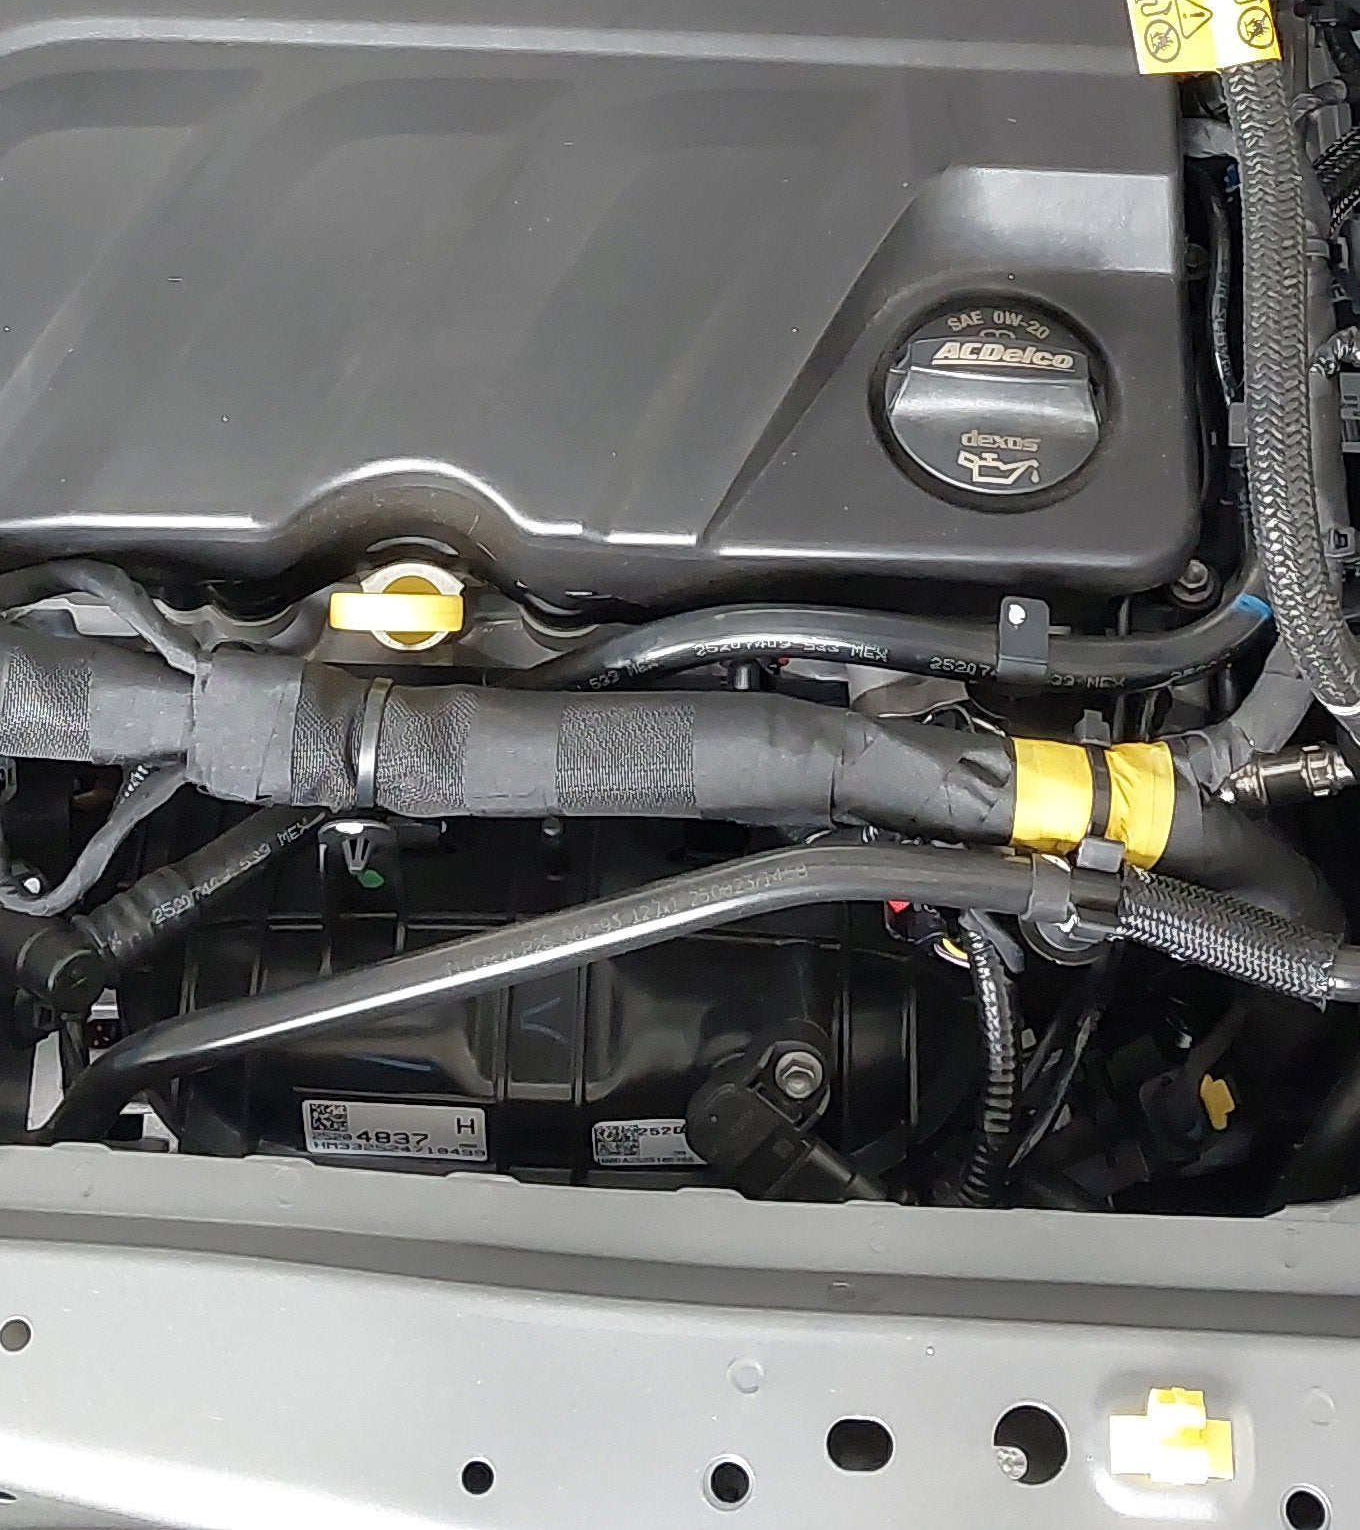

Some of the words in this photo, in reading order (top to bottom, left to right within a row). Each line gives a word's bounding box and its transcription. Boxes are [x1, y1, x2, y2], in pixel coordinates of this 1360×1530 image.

[947, 310, 985, 332] SAE
[993, 310, 1050, 340] 0W-20
[932, 341, 1074, 369] ACDelco
[961, 429, 1040, 453] dexos
[850, 642, 889, 663] MEX
[456, 1117, 476, 1135] H
[356, 1130, 430, 1146] 4837
